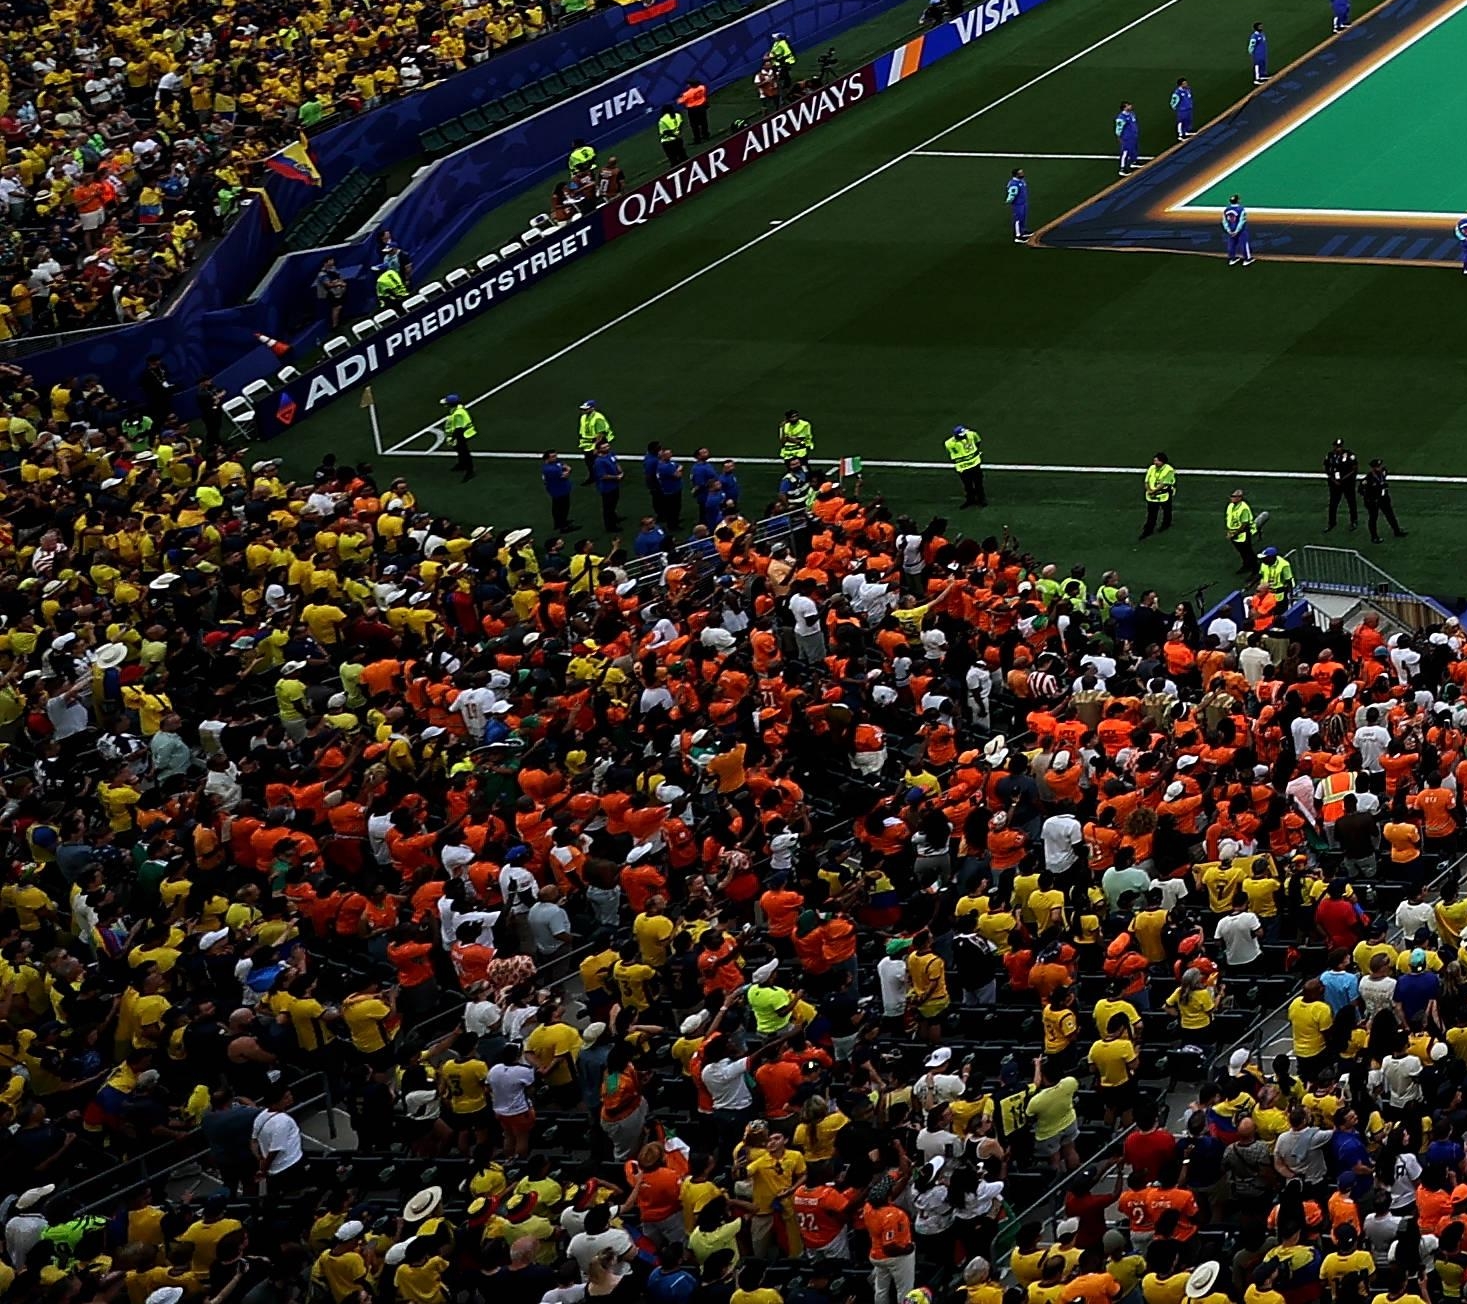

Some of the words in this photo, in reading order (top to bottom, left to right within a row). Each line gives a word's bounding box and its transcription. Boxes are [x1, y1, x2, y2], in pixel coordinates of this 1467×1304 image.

[589, 86, 645, 127] FIFA
[305, 344, 380, 410] ADI
[387, 226, 592, 357] PREDICTSTREET
[618, 147, 730, 226] QATAR
[742, 72, 865, 161] AIRWAYS
